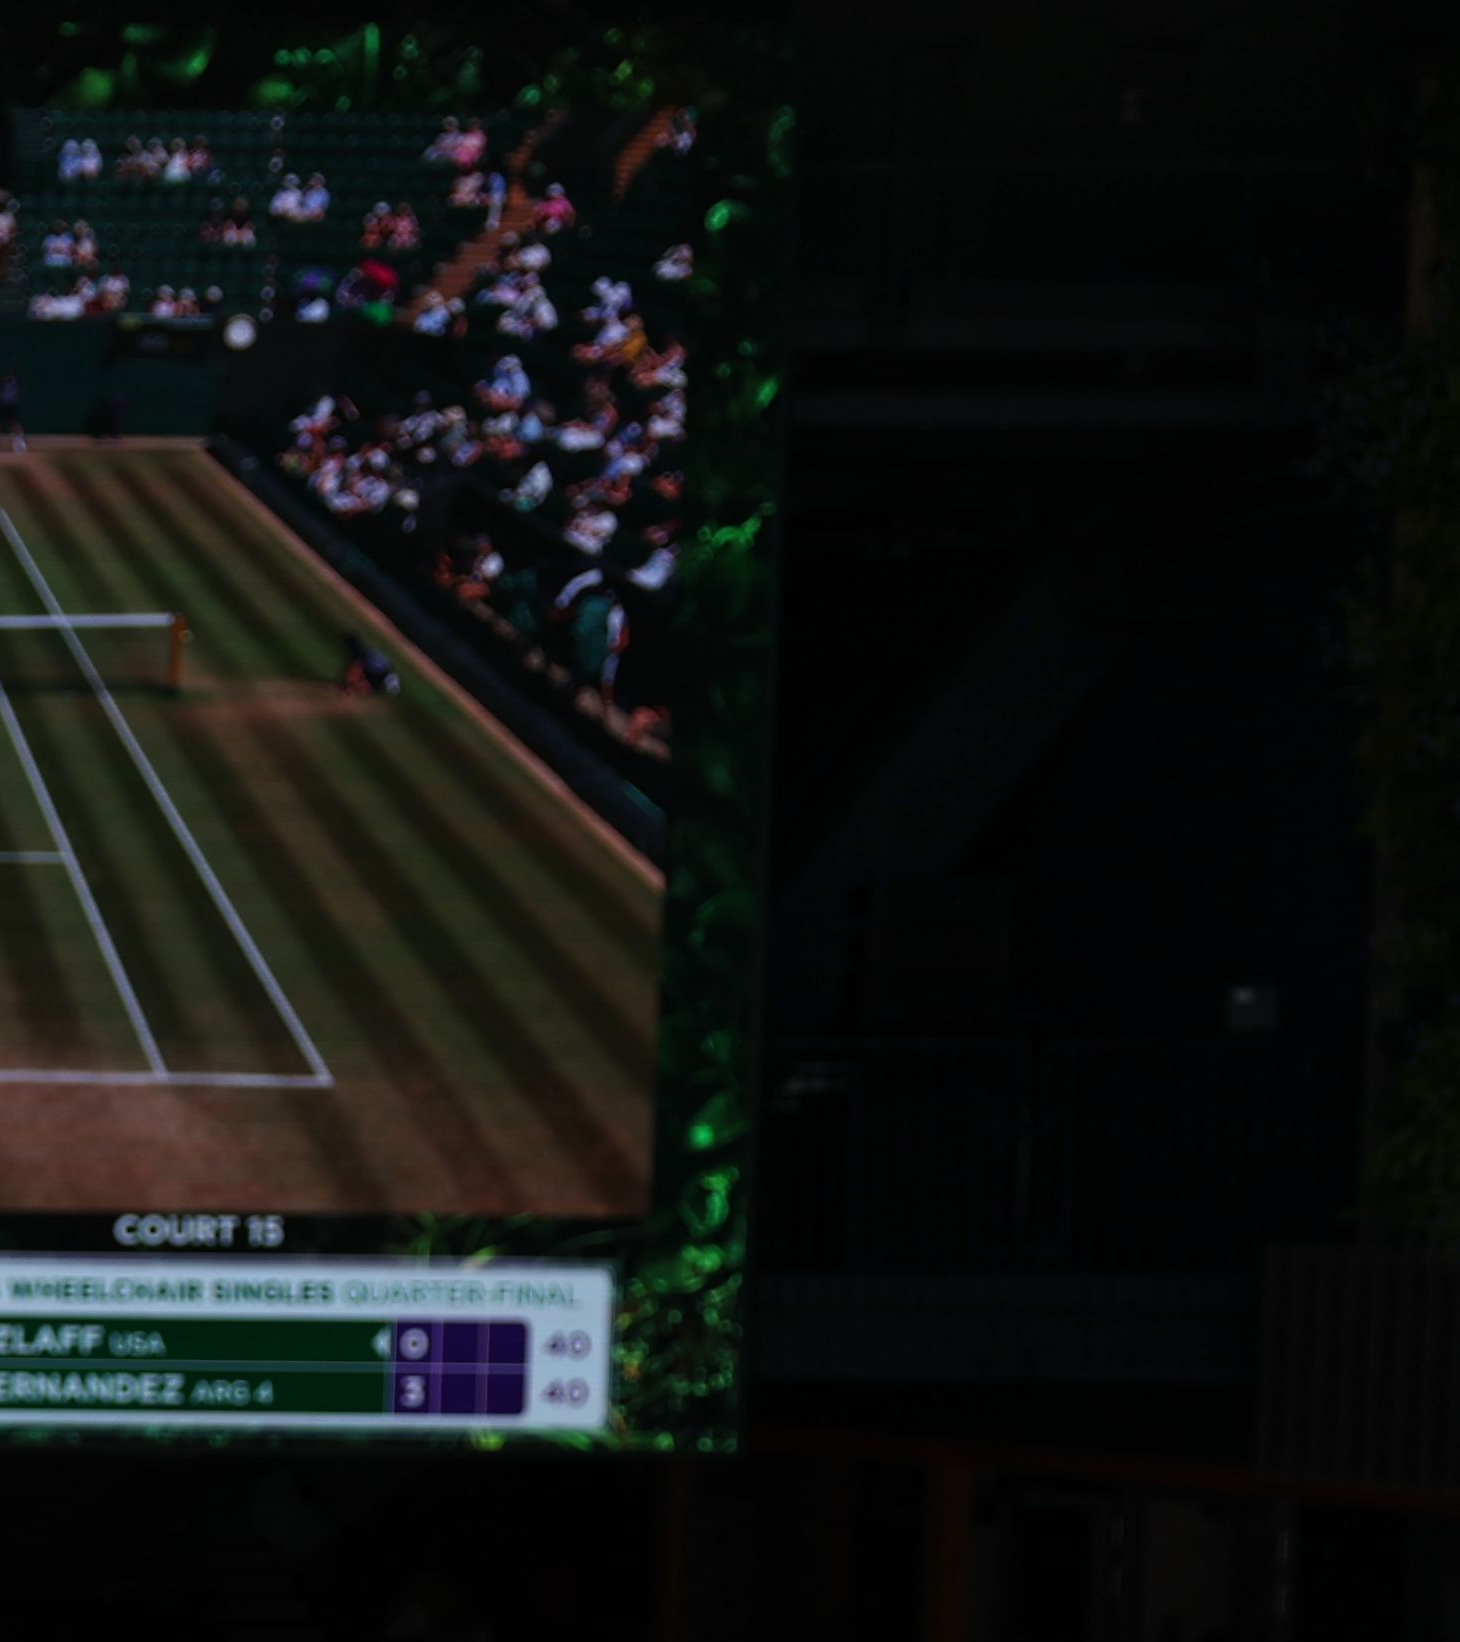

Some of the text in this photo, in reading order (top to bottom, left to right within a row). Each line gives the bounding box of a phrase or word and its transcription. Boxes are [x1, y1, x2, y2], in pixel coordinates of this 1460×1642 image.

[112, 1212, 284, 1247] COURT 15
[6, 1275, 205, 1303] WHEELCHAIR
[213, 1278, 331, 1303] SINGLES
[341, 1279, 579, 1308] QUARTER-FINAL
[109, 1331, 166, 1357] USA
[398, 1326, 430, 1361] 0
[543, 1329, 593, 1361] 40
[189, 1379, 251, 1406] ARG
[253, 1379, 275, 1406] 4
[398, 1373, 427, 1408] 3
[541, 1377, 591, 1409] 40
